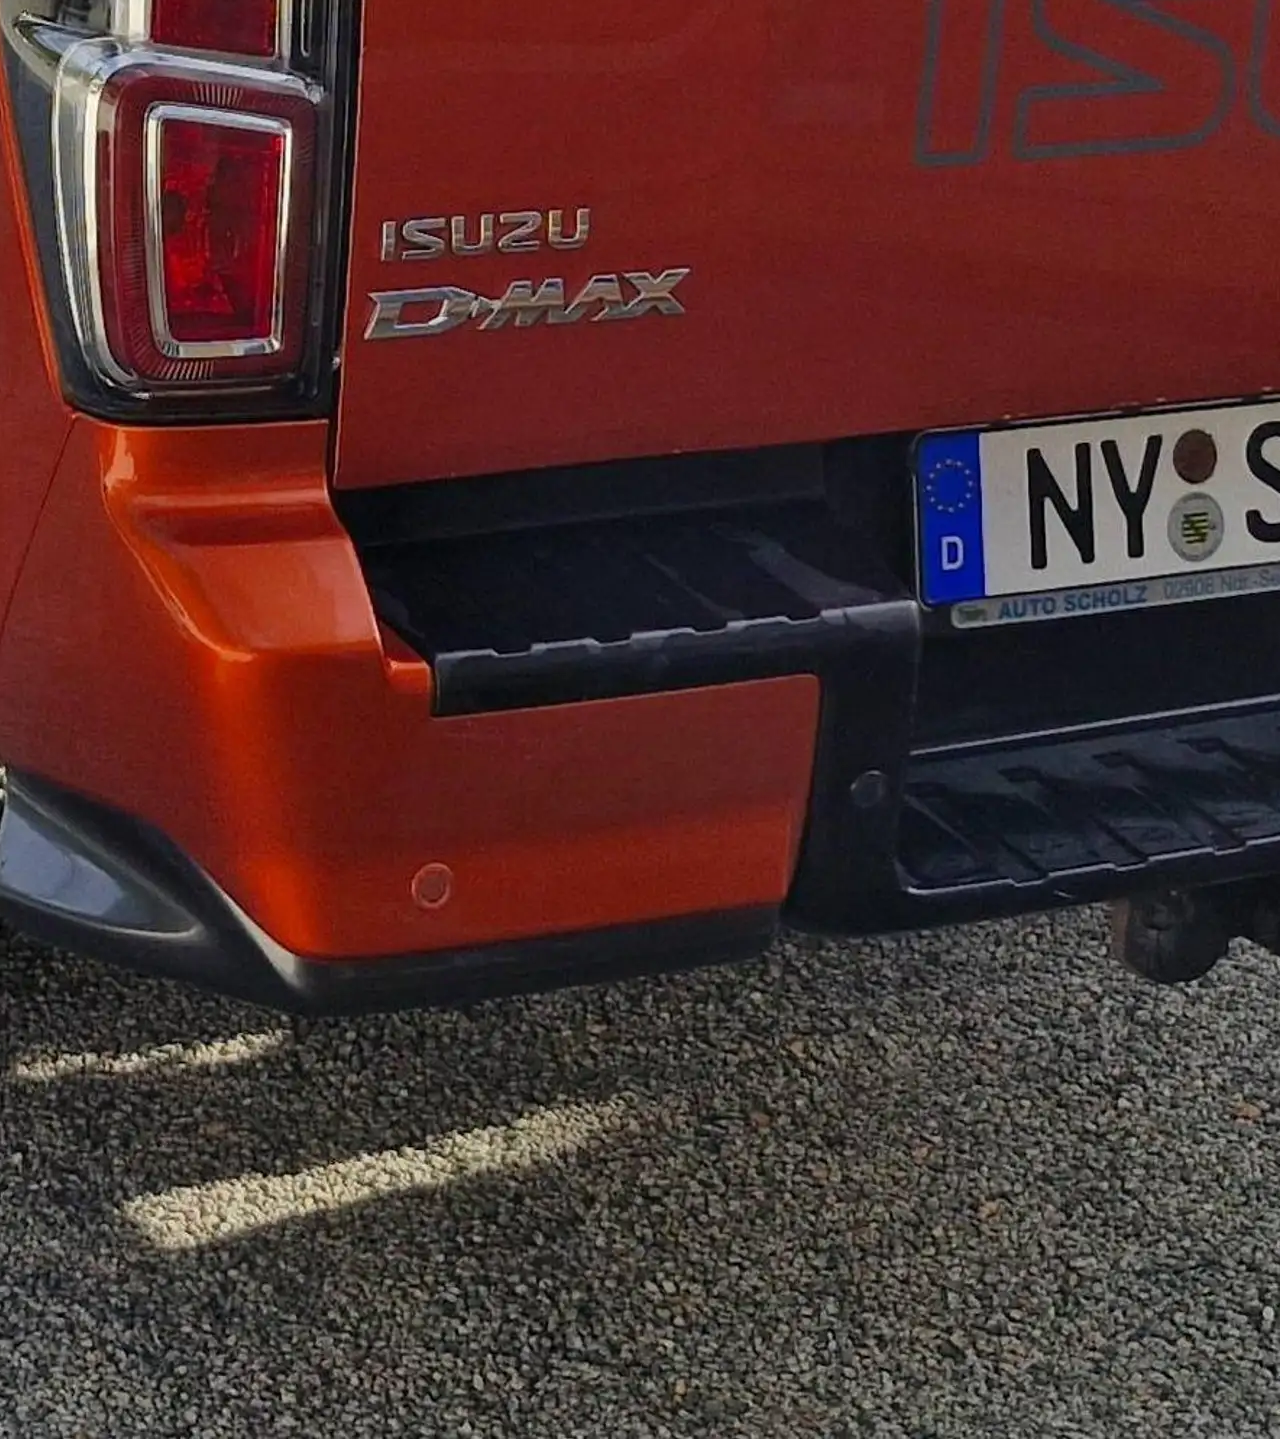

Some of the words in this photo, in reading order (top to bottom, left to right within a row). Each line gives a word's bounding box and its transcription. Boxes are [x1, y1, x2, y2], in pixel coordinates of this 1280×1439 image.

[380, 208, 590, 262] ISUZU
[364, 267, 690, 340] D-MAX
[941, 536, 964, 570] D
[1026, 434, 1164, 568] NY
[998, 597, 1058, 619] AUTO
[1064, 586, 1148, 611] SCHOLZ
